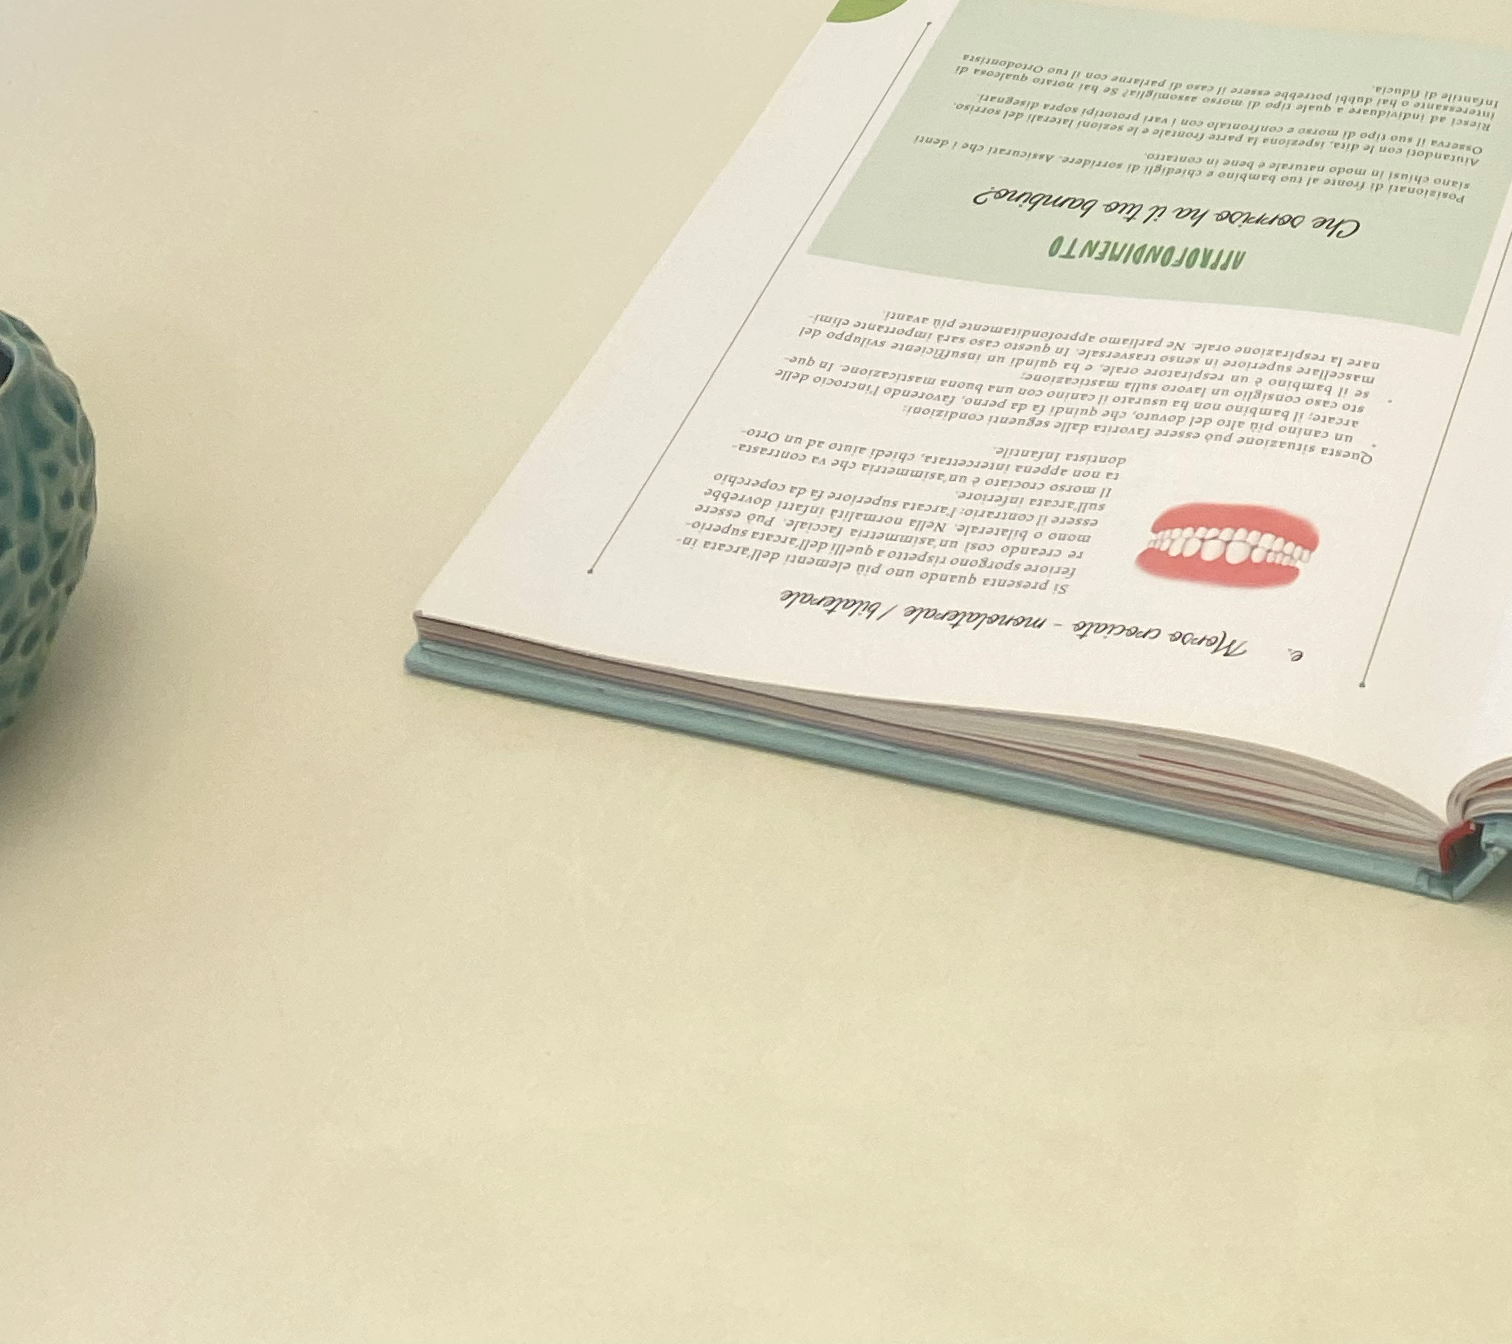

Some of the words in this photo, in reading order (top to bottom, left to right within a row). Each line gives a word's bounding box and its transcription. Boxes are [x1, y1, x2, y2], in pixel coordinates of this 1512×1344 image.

[1216, 170, 1277, 184] bambino
[1279, 173, 1303, 184] tuo
[1304, 175, 1320, 187] al
[1321, 176, 1366, 191] fronte
[1368, 181, 1384, 193] di
[971, 185, 1099, 218] bambino?
[1386, 182, 1465, 204] Posizionati
[1100, 199, 1144, 223] tuo
[1140, 203, 1168, 224] il
[1170, 205, 1211, 228] ha
[1211, 208, 1306, 229] sorriso
[1309, 214, 1361, 239] Che
[1046, 233, 1247, 271] APPROFONDIMENTO
[674, 534, 699, 549] in-
[701, 538, 781, 564] dell'arcata
[781, 552, 852, 573] elementi
[854, 561, 883, 576] più
[884, 565, 915, 578] uno
[917, 569, 977, 585] quando
[981, 576, 1051, 590] presenta
[1050, 581, 1070, 595] Si
[902, 603, 1048, 631] monolaterale
[1070, 618, 1162, 640] crociato
[1166, 628, 1248, 657] Morso
